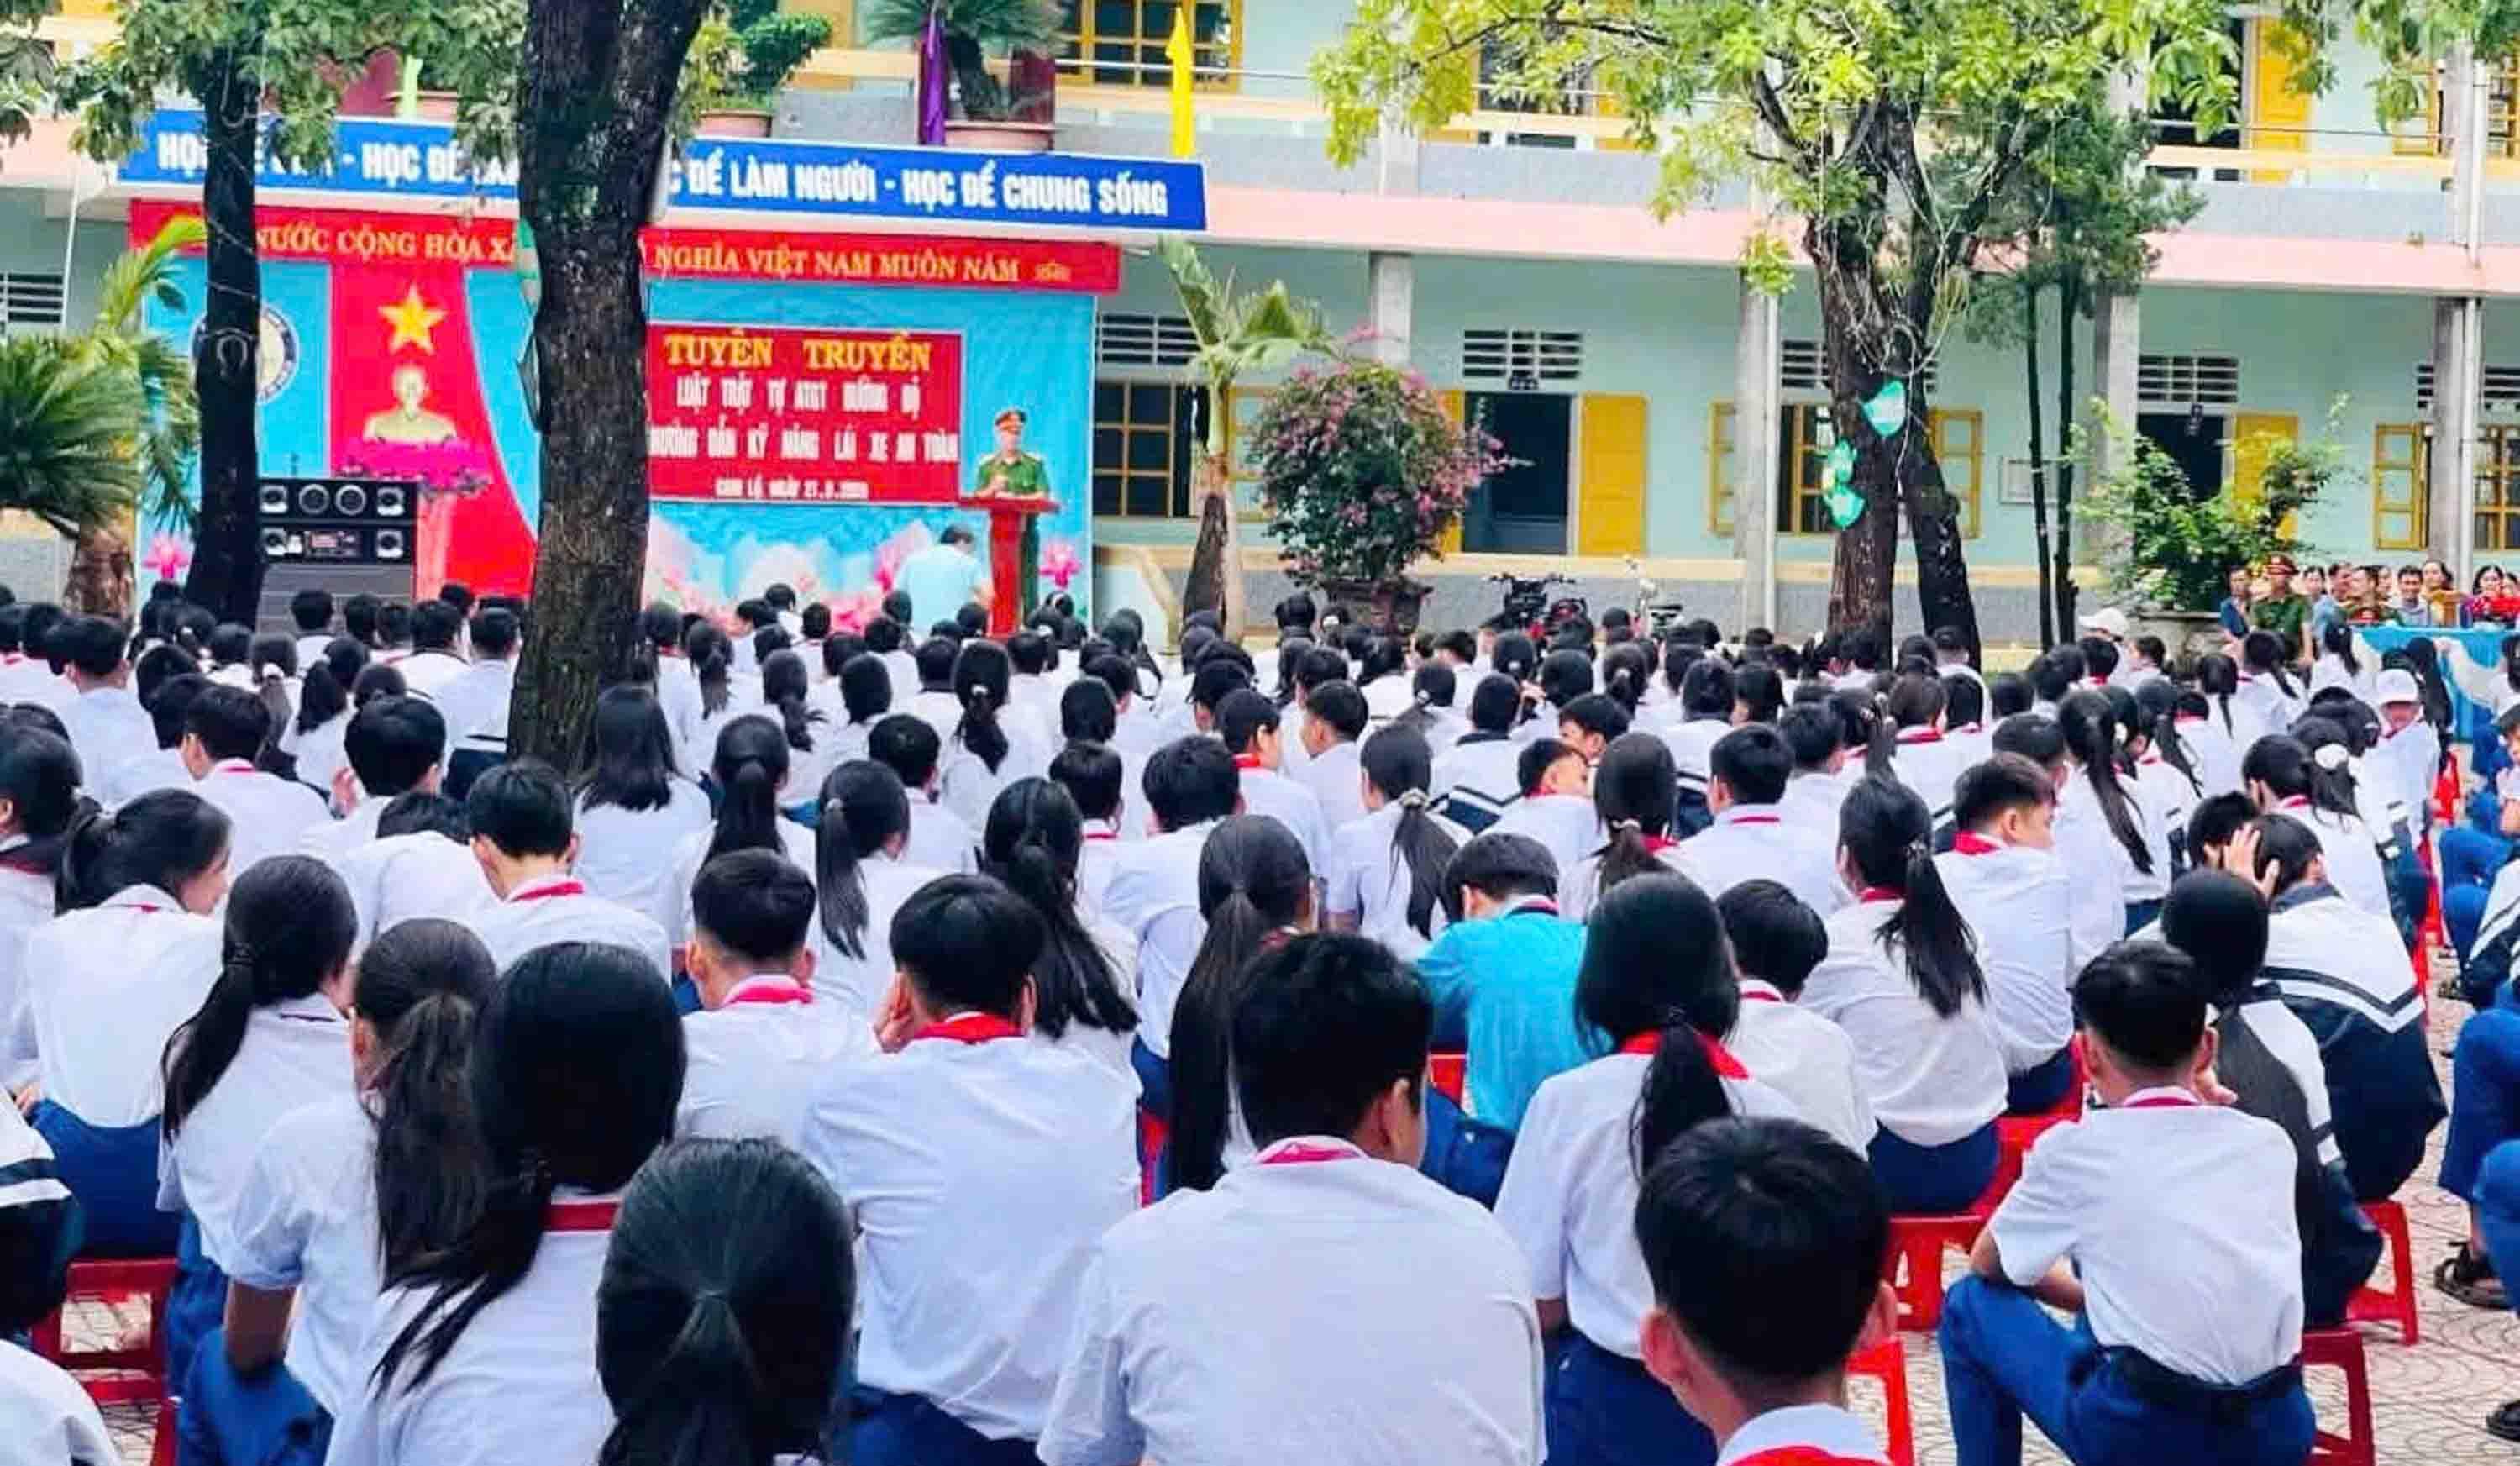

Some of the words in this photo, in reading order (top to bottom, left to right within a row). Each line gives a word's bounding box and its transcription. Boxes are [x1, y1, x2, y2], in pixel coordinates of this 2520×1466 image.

[362, 141, 420, 187] HỌC
[689, 146, 725, 196] ĐỂ
[730, 154, 788, 198] LÀM
[794, 159, 877, 202] NGƯỜI
[902, 168, 955, 212] HỌC
[960, 158, 997, 208] ĐỂ
[1002, 173, 1091, 211] CHUNG
[1097, 170, 1168, 217] SỐNG
[337, 223, 415, 262] CỘNG
[424, 229, 484, 262] HÒA
[654, 240, 740, 271] NGHĨA
[746, 243, 807, 279] VIỆT
[815, 251, 873, 277] NAM
[881, 248, 956, 280] MUÔN
[963, 251, 1020, 282] NĂM
[664, 328, 774, 367] TUYÊN
